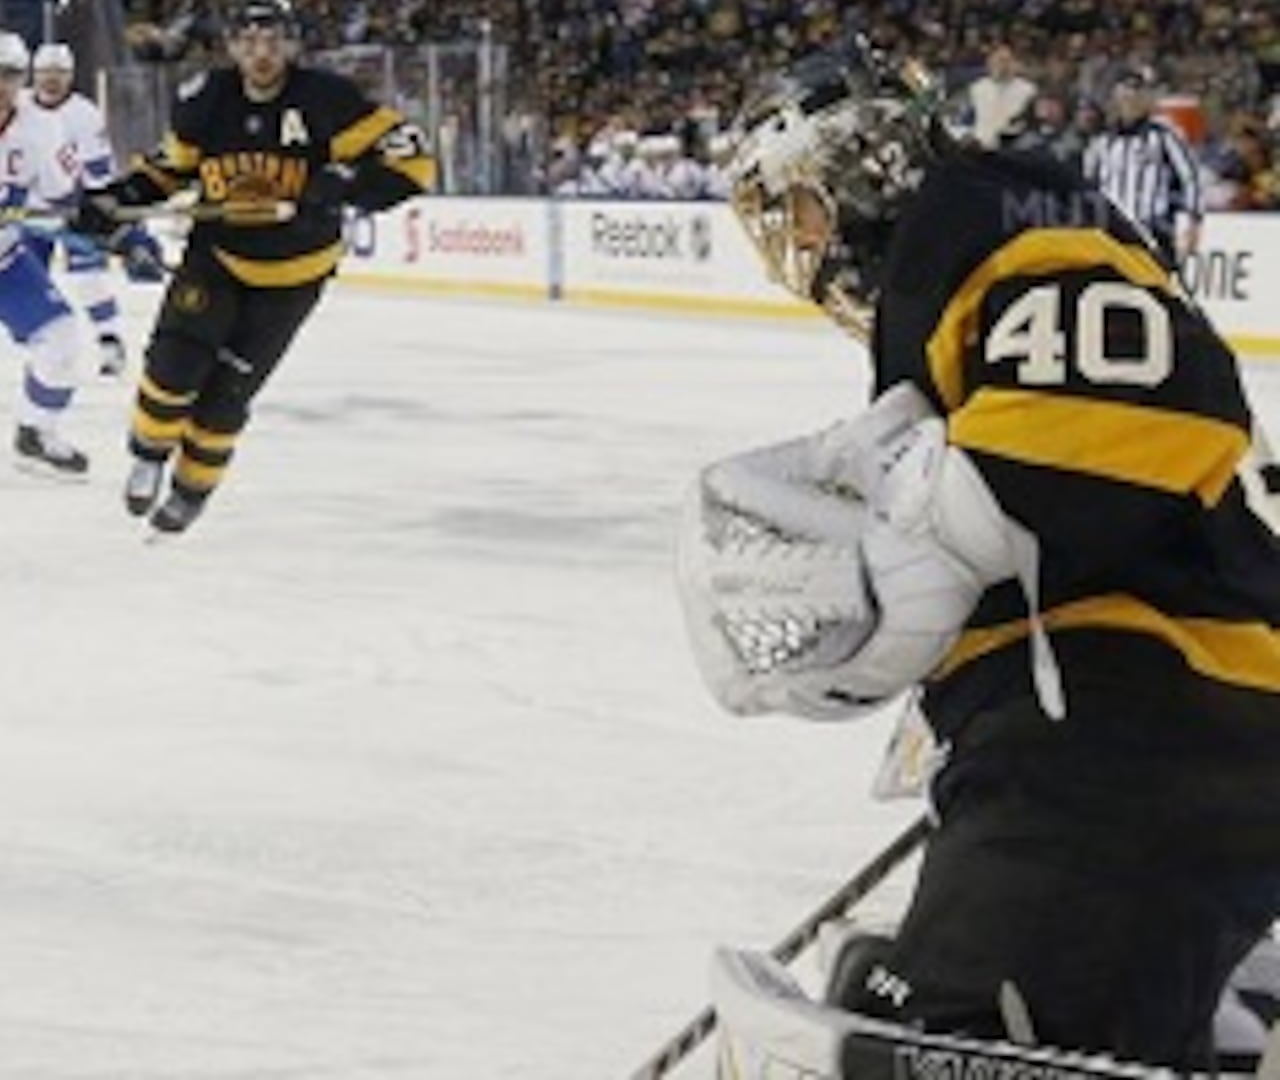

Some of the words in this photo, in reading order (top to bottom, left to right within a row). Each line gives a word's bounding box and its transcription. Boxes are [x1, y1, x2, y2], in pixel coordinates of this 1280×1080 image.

[280, 108, 309, 147] A
[7, 148, 23, 176] C
[591, 212, 683, 258] Reebok
[983, 281, 1175, 387] 40
